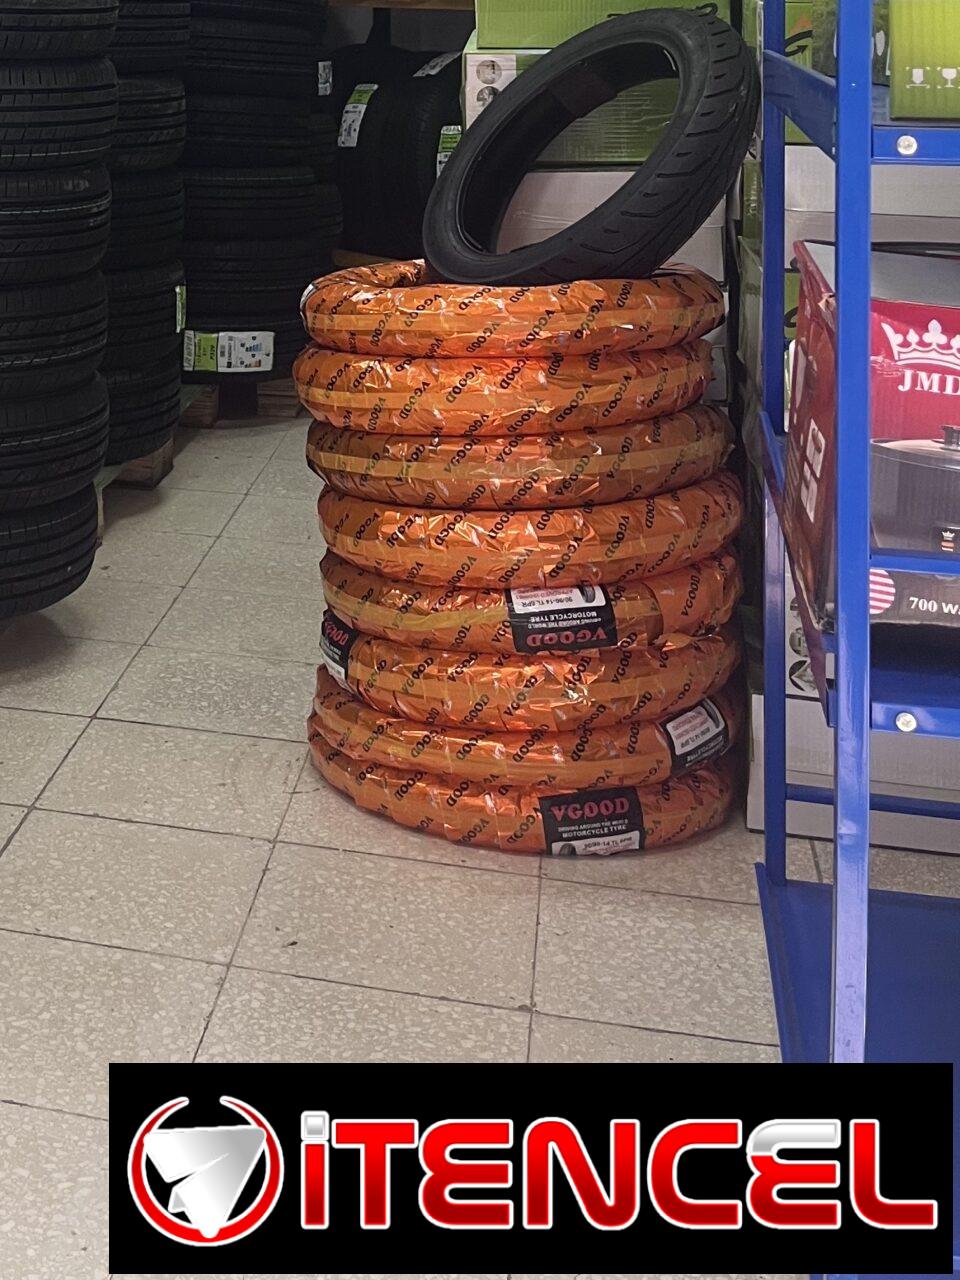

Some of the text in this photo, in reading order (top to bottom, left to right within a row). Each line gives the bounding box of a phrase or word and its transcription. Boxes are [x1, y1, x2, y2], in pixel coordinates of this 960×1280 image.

[399, 380, 431, 420] VGOOD
[446, 364, 484, 404] VGOOD
[602, 375, 632, 418] VGOOD
[898, 369, 960, 396] JMD
[556, 383, 592, 423] VGOOD
[555, 455, 589, 497] VGOOD
[606, 436, 634, 480] VGOOD
[605, 515, 629, 559] VGOOD
[549, 536, 583, 579] VGOOD
[529, 611, 597, 623] MOTORCYCLE TYRE
[909, 596, 938, 613] 700
[492, 621, 511, 644] VGO
[526, 627, 607, 647] VGOOD
[550, 797, 629, 822] VGOOD
[562, 825, 627, 838] MOTORCYCLE TYRE
